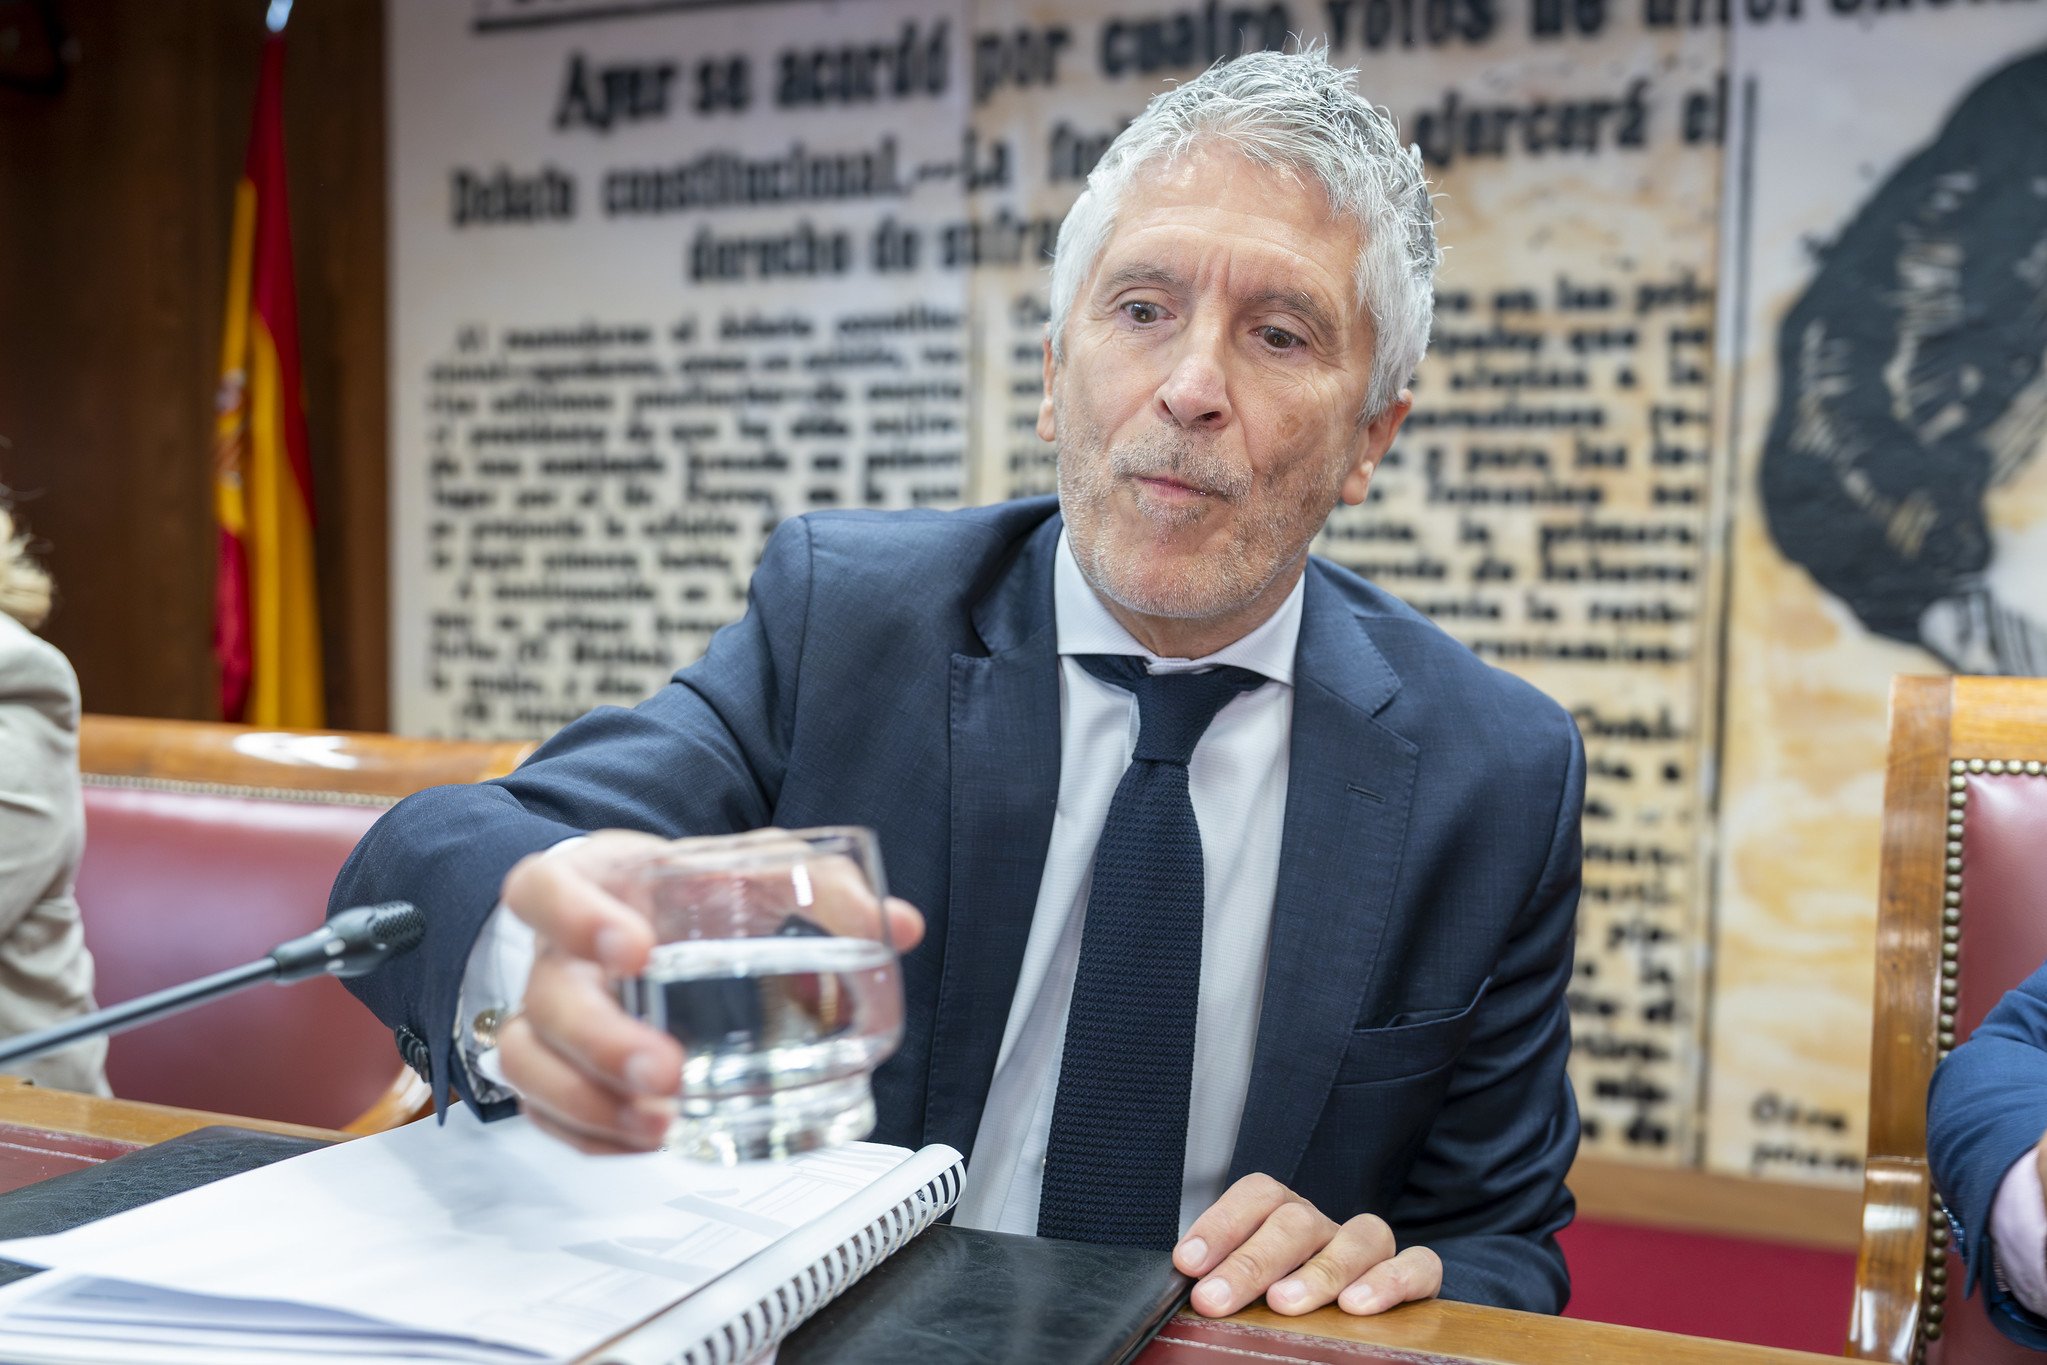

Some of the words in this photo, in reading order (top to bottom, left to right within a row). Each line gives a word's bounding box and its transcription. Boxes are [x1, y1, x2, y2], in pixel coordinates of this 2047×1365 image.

[555, 50, 677, 131] Ayer
[691, 54, 752, 114] se
[976, 27, 1072, 101] por
[450, 163, 576, 228] Debate
[689, 224, 852, 284] derecho
[876, 215, 922, 274] de
